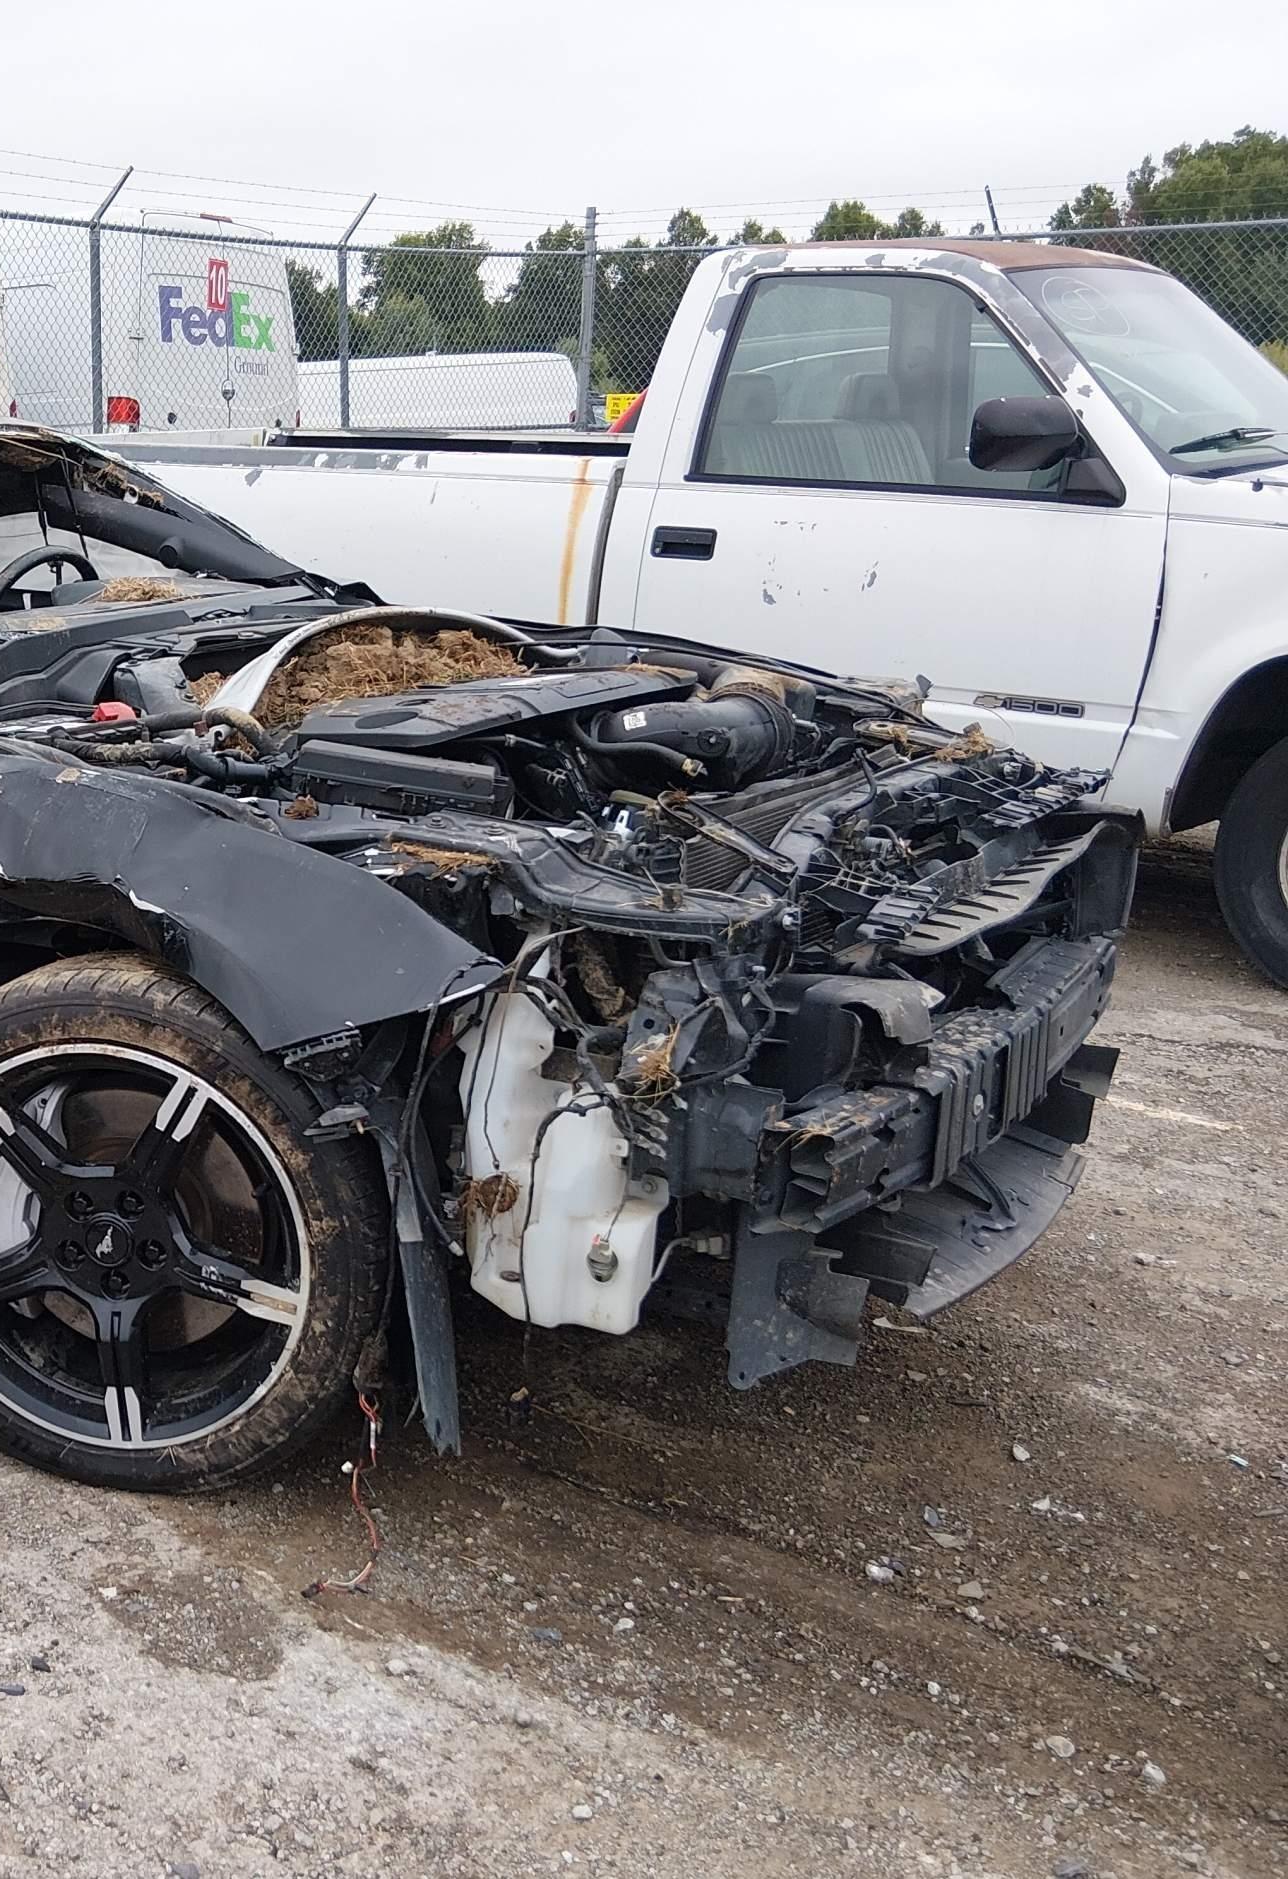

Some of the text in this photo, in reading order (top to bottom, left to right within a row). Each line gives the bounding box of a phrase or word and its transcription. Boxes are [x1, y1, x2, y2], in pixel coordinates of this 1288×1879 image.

[210, 265, 226, 306] 10
[158, 285, 275, 352] FedEx
[1003, 697, 1084, 718] 1500
